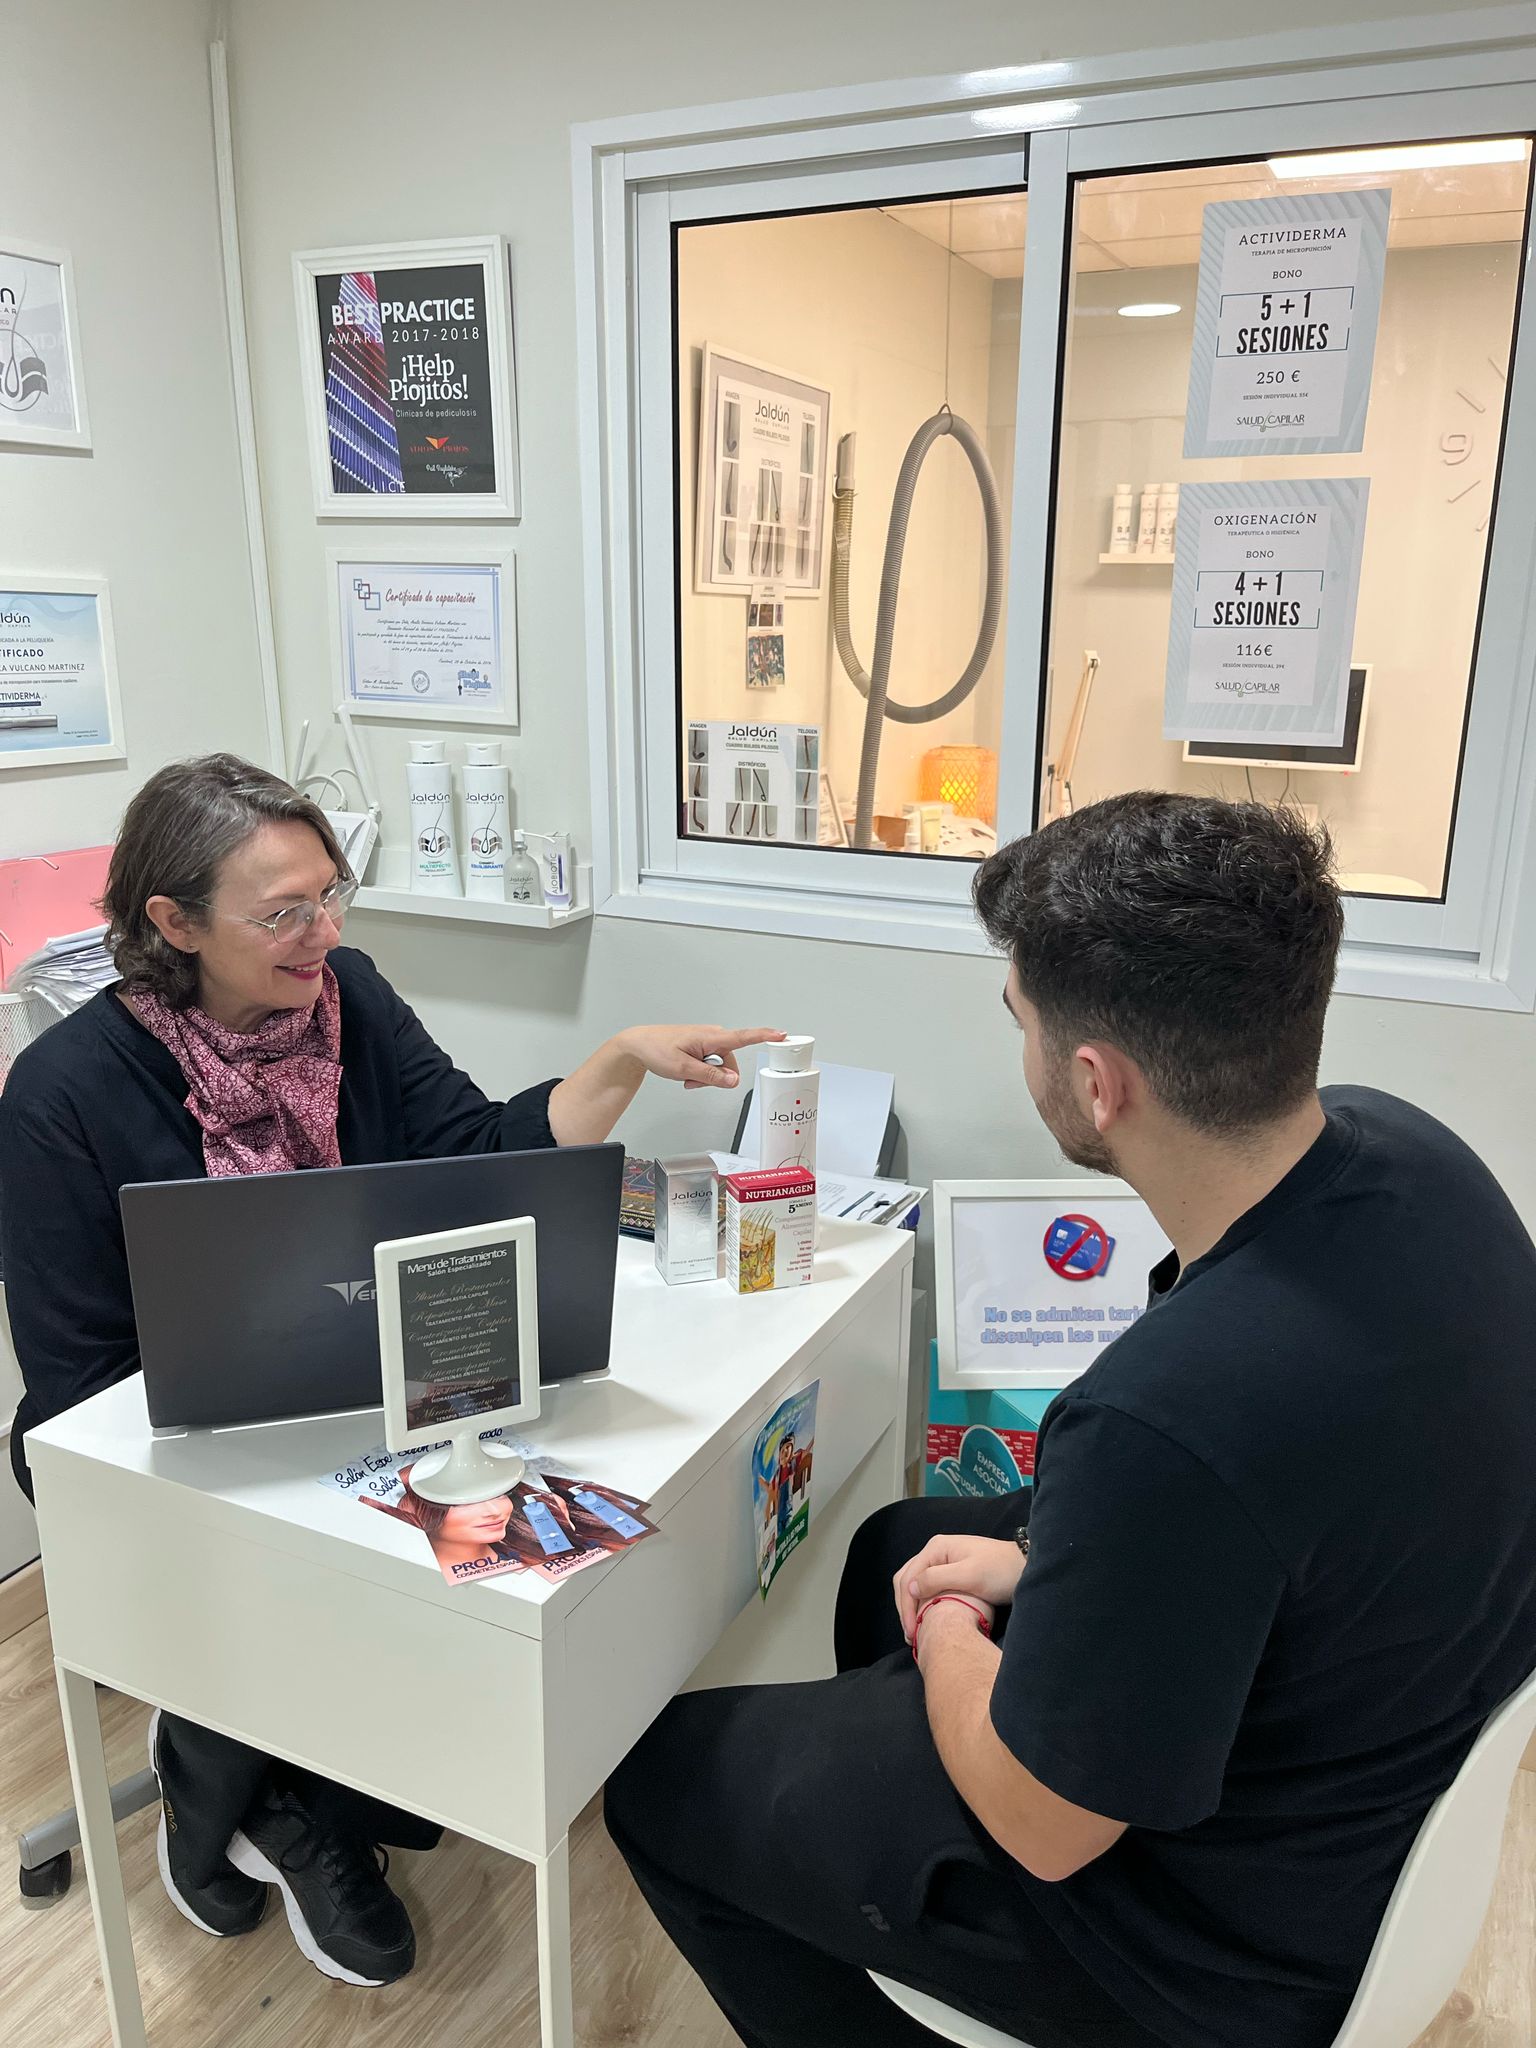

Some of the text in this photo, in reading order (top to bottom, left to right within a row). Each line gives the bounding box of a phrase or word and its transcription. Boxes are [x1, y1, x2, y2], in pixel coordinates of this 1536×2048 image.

[1238, 227, 1347, 246] ACTIVIDERMA
[1286, 245, 1332, 254] MICROPUNCIÓN
[1272, 269, 1303, 280] BONO
[331, 298, 475, 326] BEST PRACTICE
[1260, 291, 1312, 321] 5 + 1
[327, 327, 480, 345] AWARD 2017-2018
[1236, 323, 1330, 355] SESIONES
[402, 353, 455, 384] ¡Help
[1256, 370, 1301, 385] 250 €
[389, 375, 469, 407] Piojitos!
[425, 409, 434, 418] de
[436, 408, 477, 419] pediculosis
[755, 400, 790, 424] Jaldún
[1236, 414, 1305, 425] SALUD CAPILAR
[1213, 511, 1317, 526] OXIGENACIÓN
[1245, 550, 1275, 559] BONO
[1234, 571, 1283, 596] 4 + 1
[385, 588, 477, 607] Certificado de capacitación
[1212, 601, 1301, 626] SESIONES
[9, 664, 46, 672] VULCANO
[48, 663, 86, 671] MARTINEZ
[1215, 681, 1281, 692] SALUD CAPILAR
[727, 725, 777, 738] Jaldún
[411, 793, 451, 802] Jaldún
[466, 792, 505, 802] Jaldún
[738, 1169, 801, 1181] NUTRIANAGEN
[671, 1190, 713, 1201] Jaldún
[745, 1183, 814, 1200] NUTRIANAGEN
[788, 1203, 796, 1214] 5
[407, 1249, 508, 1275] Menú de Tratamientos
[427, 1260, 492, 1277] Salón Especializado
[467, 1290, 489, 1300] CAPILAR
[984, 1306, 1008, 1323] No
[1011, 1309, 1032, 1322] se
[1035, 1306, 1105, 1322] admiten
[981, 1328, 1064, 1346] disculpen
[1067, 1327, 1095, 1343] las
[977, 1450, 1011, 1489] EMPRESA
[334, 1468, 369, 1489] Salón
[368, 1475, 402, 1497] Salón
[456, 1565, 497, 1579] COSMETICS
[553, 1557, 588, 1575] COSMETICS
